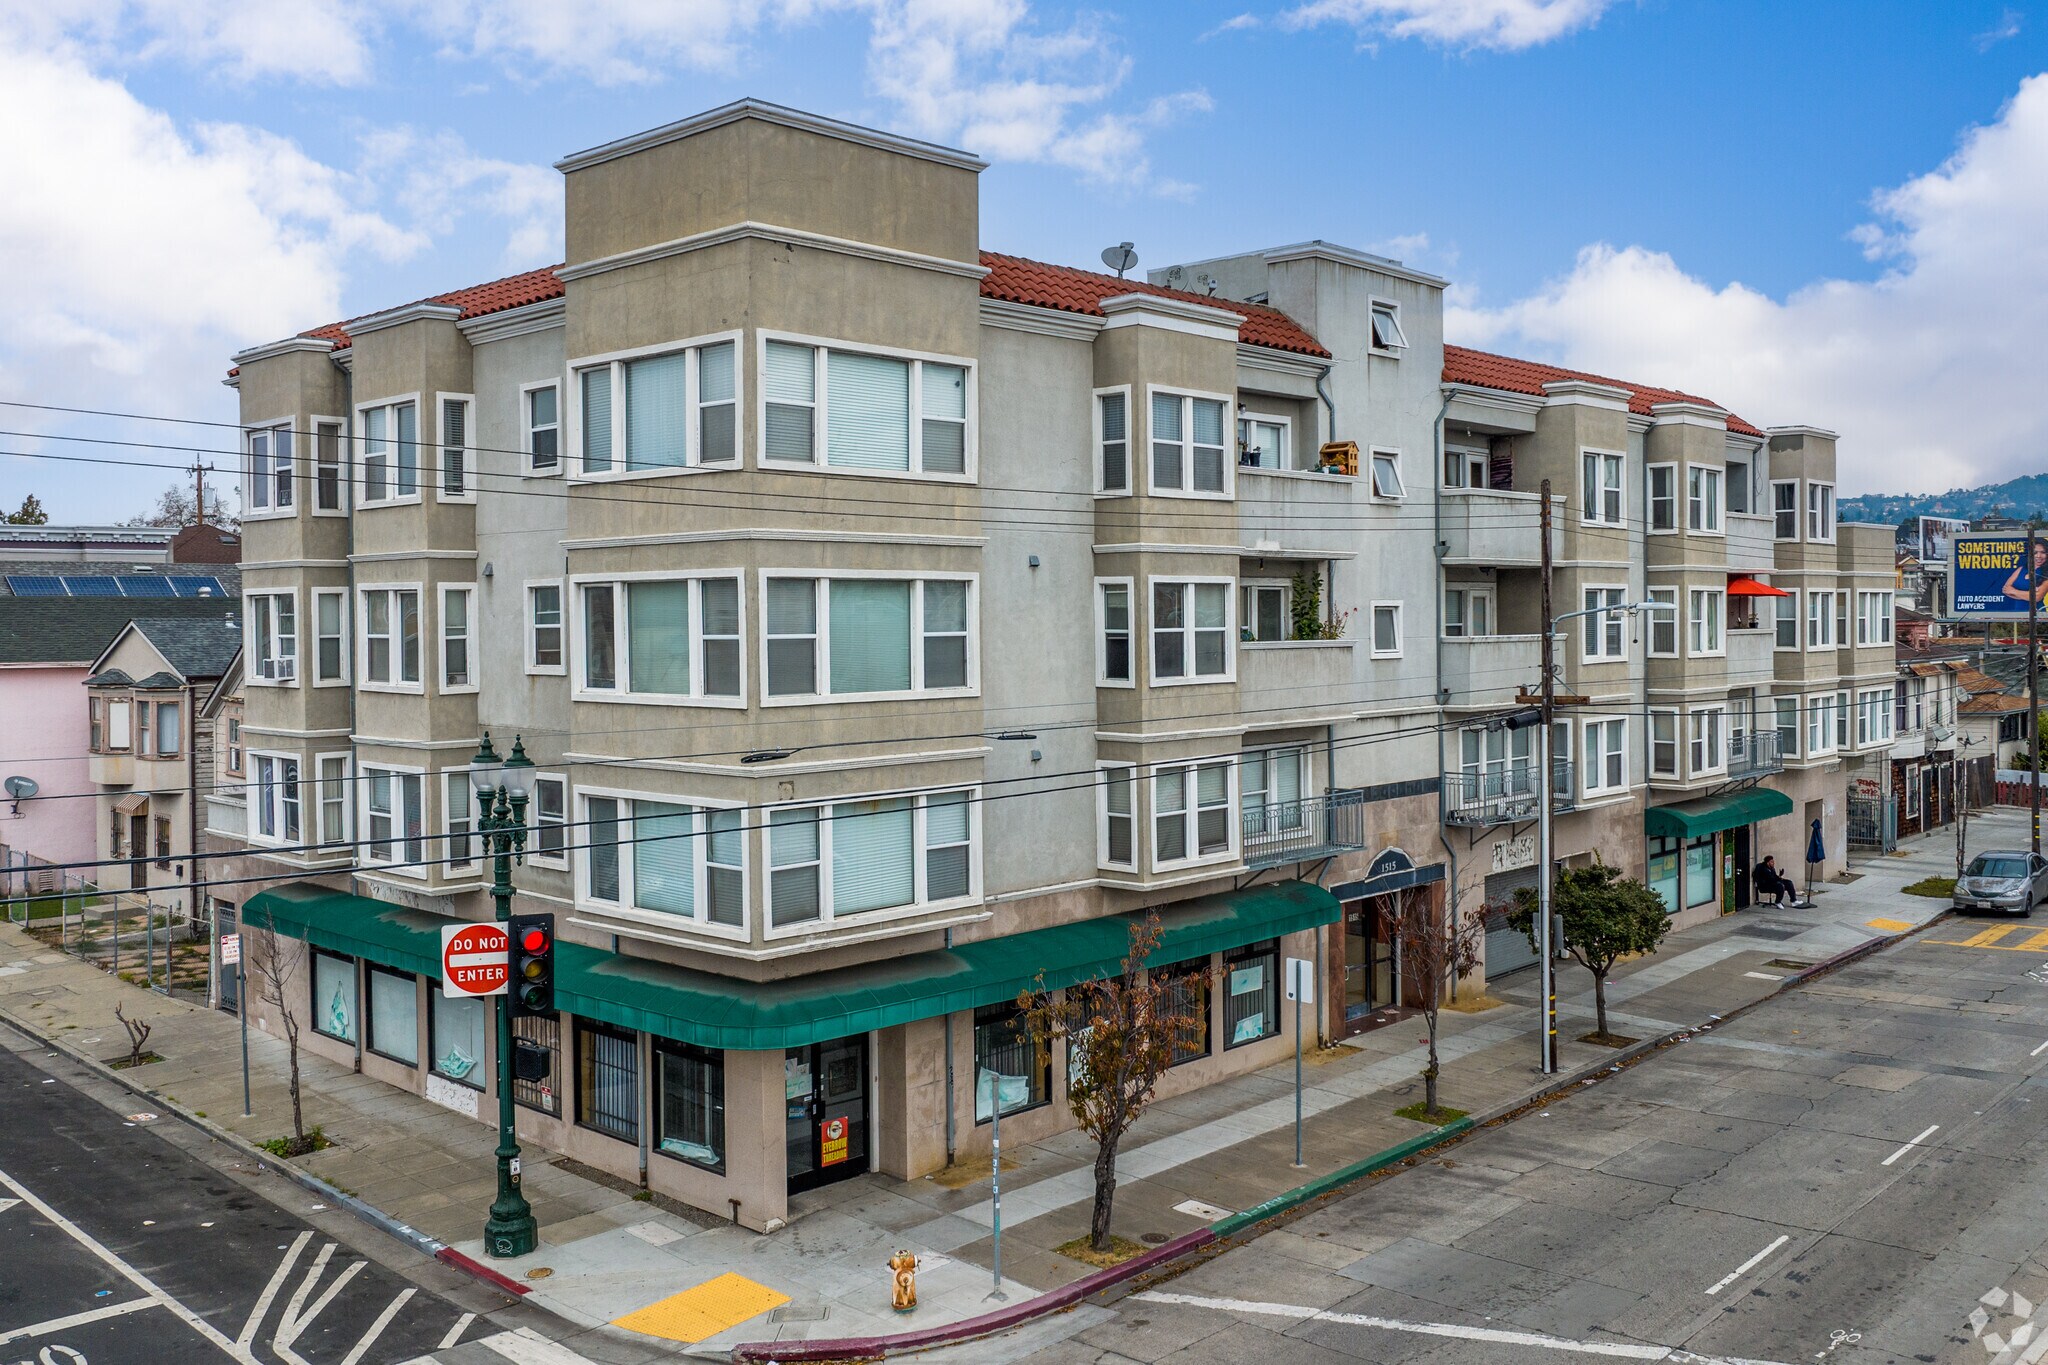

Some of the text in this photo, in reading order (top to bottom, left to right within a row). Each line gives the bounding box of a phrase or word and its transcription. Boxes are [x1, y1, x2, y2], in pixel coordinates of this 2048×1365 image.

[1958, 541, 2025, 554] SOMETHING
[1958, 554, 2020, 569] WRONG?
[1381, 861, 1396, 872] 1515
[454, 937, 506, 951] DO NOT
[458, 968, 504, 982] ENTER
